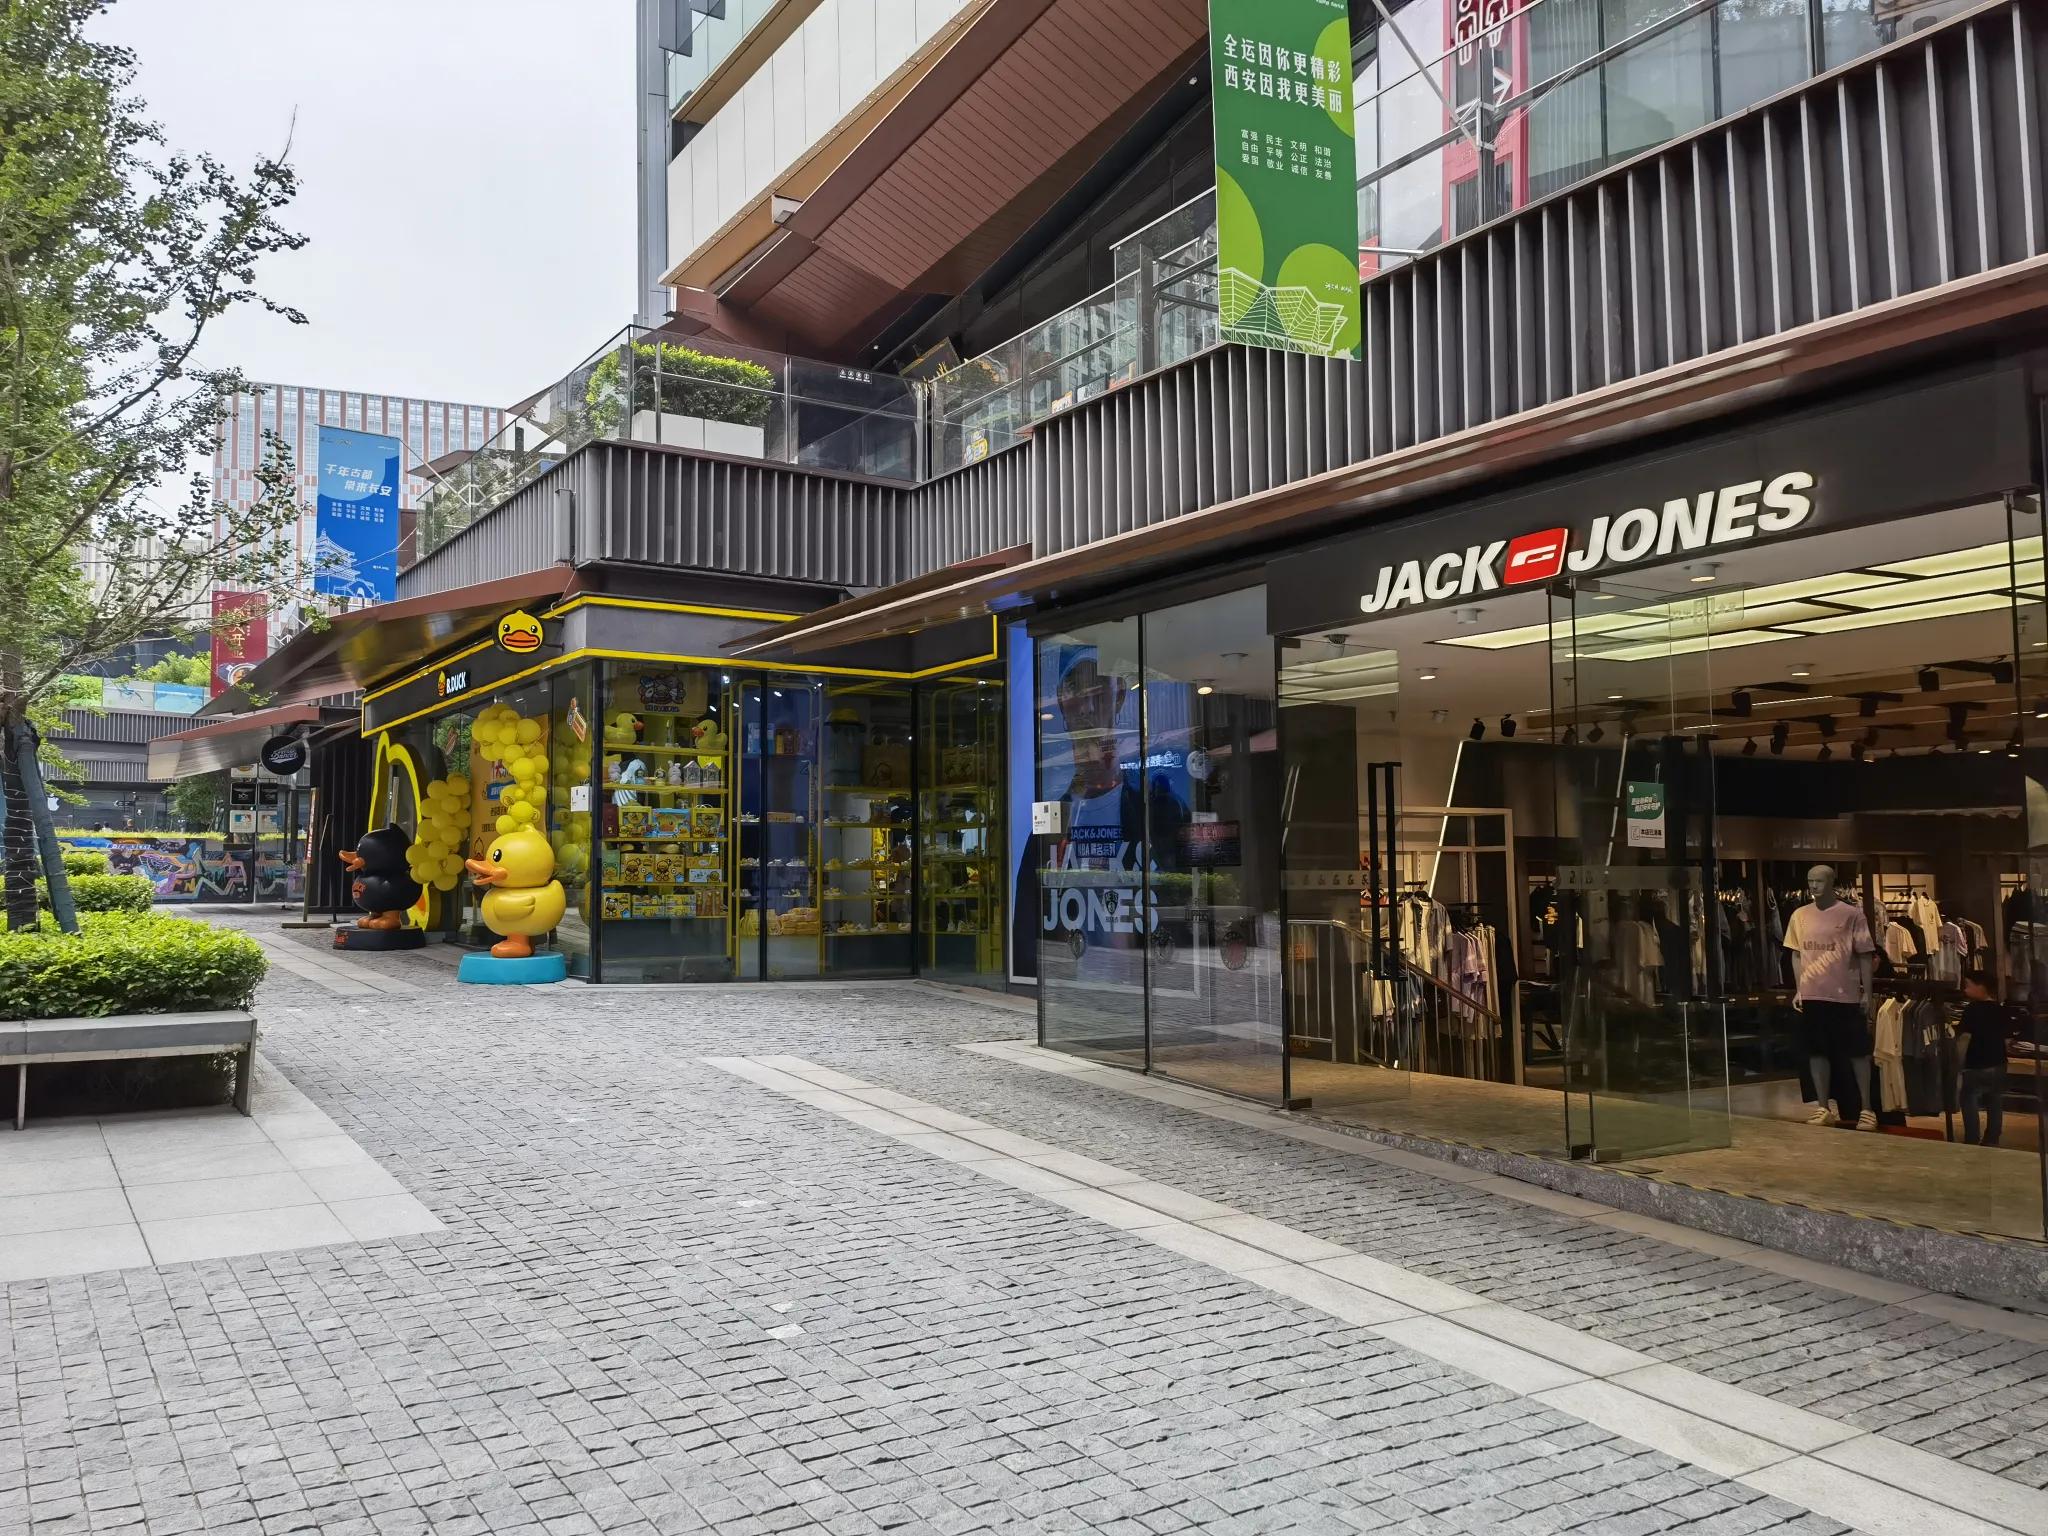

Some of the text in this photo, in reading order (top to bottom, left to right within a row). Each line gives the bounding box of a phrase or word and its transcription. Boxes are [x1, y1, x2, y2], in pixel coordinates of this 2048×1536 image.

[1223, 33, 1341, 83] 全运因你更精彩
[1224, 63, 1342, 113] 西安因我更美丽
[1241, 141, 1332, 169] 自由 平等 公正 法治
[1265, 134, 1283, 147] 民主
[1290, 140, 1307, 152] 文明
[1266, 158, 1284, 171] 敬业
[324, 463, 374, 481] 千年古都
[1360, 470, 1814, 614] JACK JONES
[446, 671, 466, 694] B.DUCK
[1043, 887, 1159, 935] JONES
